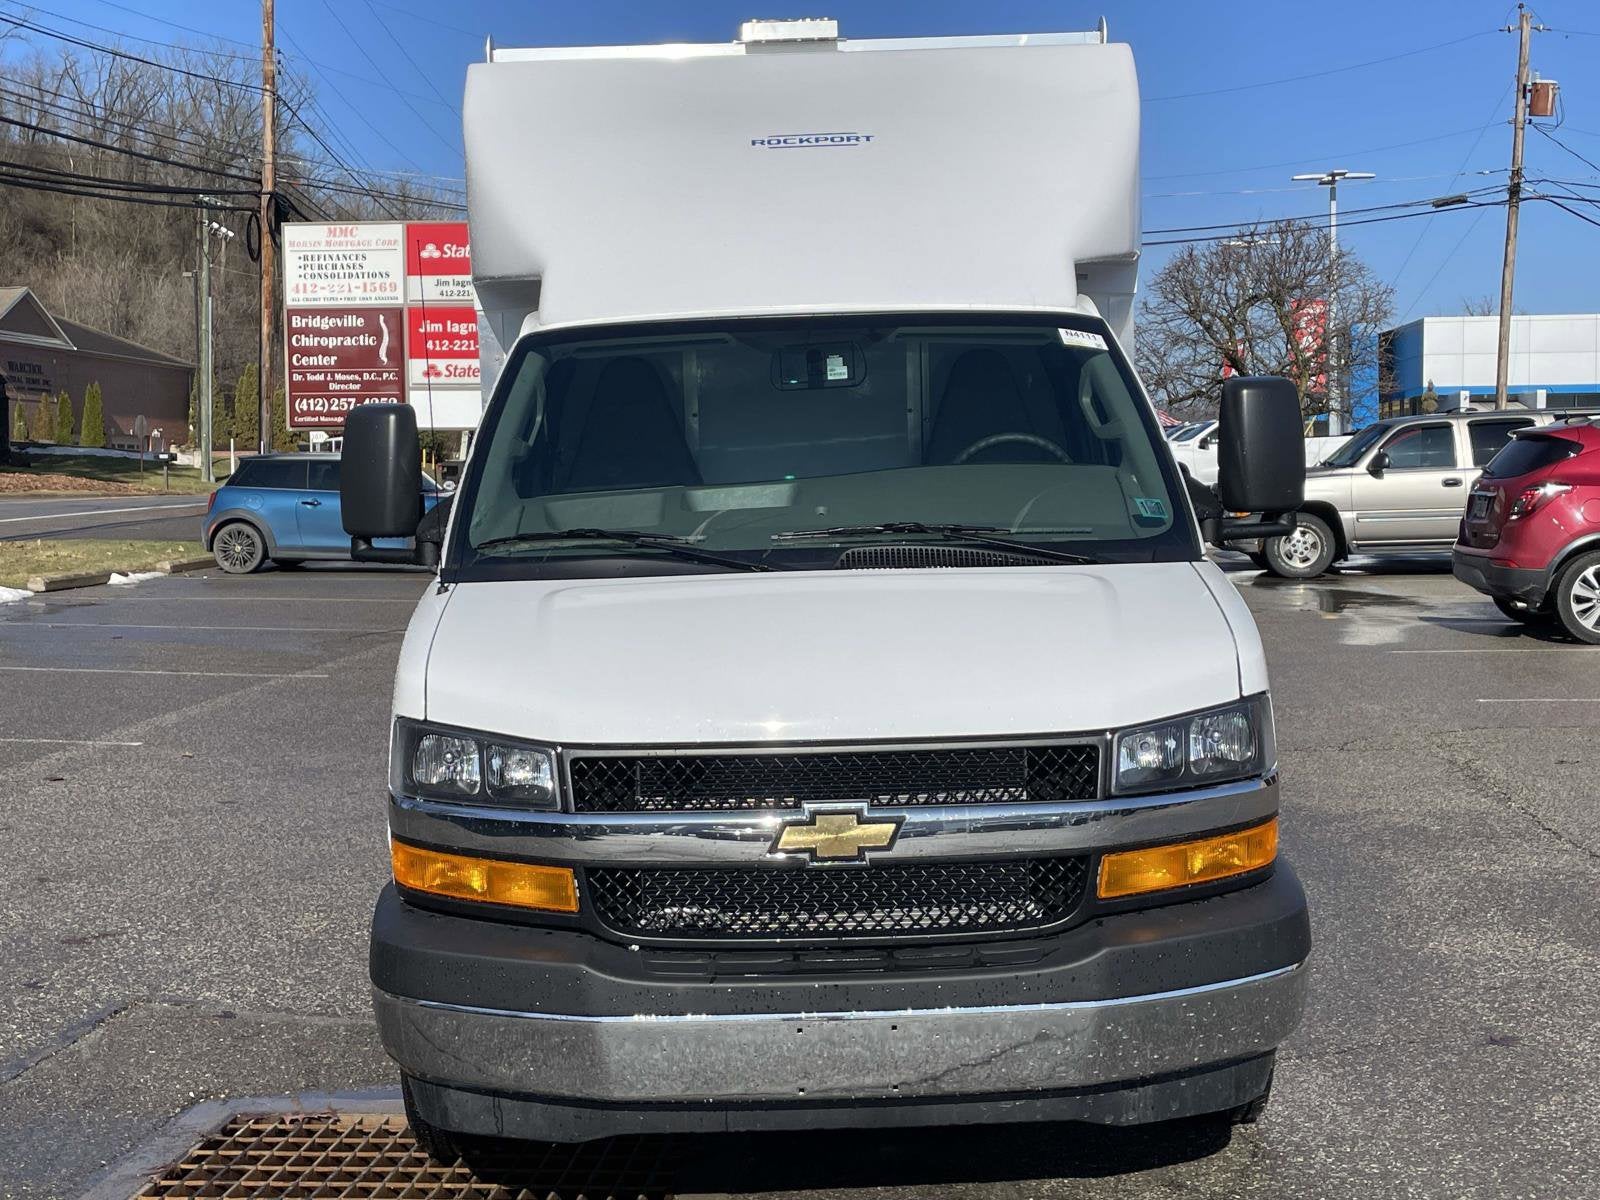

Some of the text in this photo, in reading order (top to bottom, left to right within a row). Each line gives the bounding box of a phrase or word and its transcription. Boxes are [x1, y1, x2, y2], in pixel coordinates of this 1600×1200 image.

[751, 135, 874, 146] ROCKPORT
[326, 226, 358, 238] MMC
[303, 254, 367, 262] REFINANCES
[303, 262, 364, 270] PURCHASES
[303, 271, 390, 280] CONSOLIDATIONS
[291, 282, 397, 294] 412-221-1569
[434, 279, 450, 287] Jim
[291, 315, 365, 330] Bridgeville
[419, 320, 442, 333] Jim
[291, 334, 377, 348] Chiropractic
[292, 353, 338, 366] Center
[445, 363, 480, 378] State
[292, 373, 305, 381] Dr.
[306, 373, 324, 381] Todd
[326, 373, 333, 381] J.
[335, 373, 361, 382] Moses,
[383, 372, 398, 380] P.C.
[329, 382, 361, 390] Director
[294, 397, 329, 413] (412)
[320, 415, 344, 423] Massage
